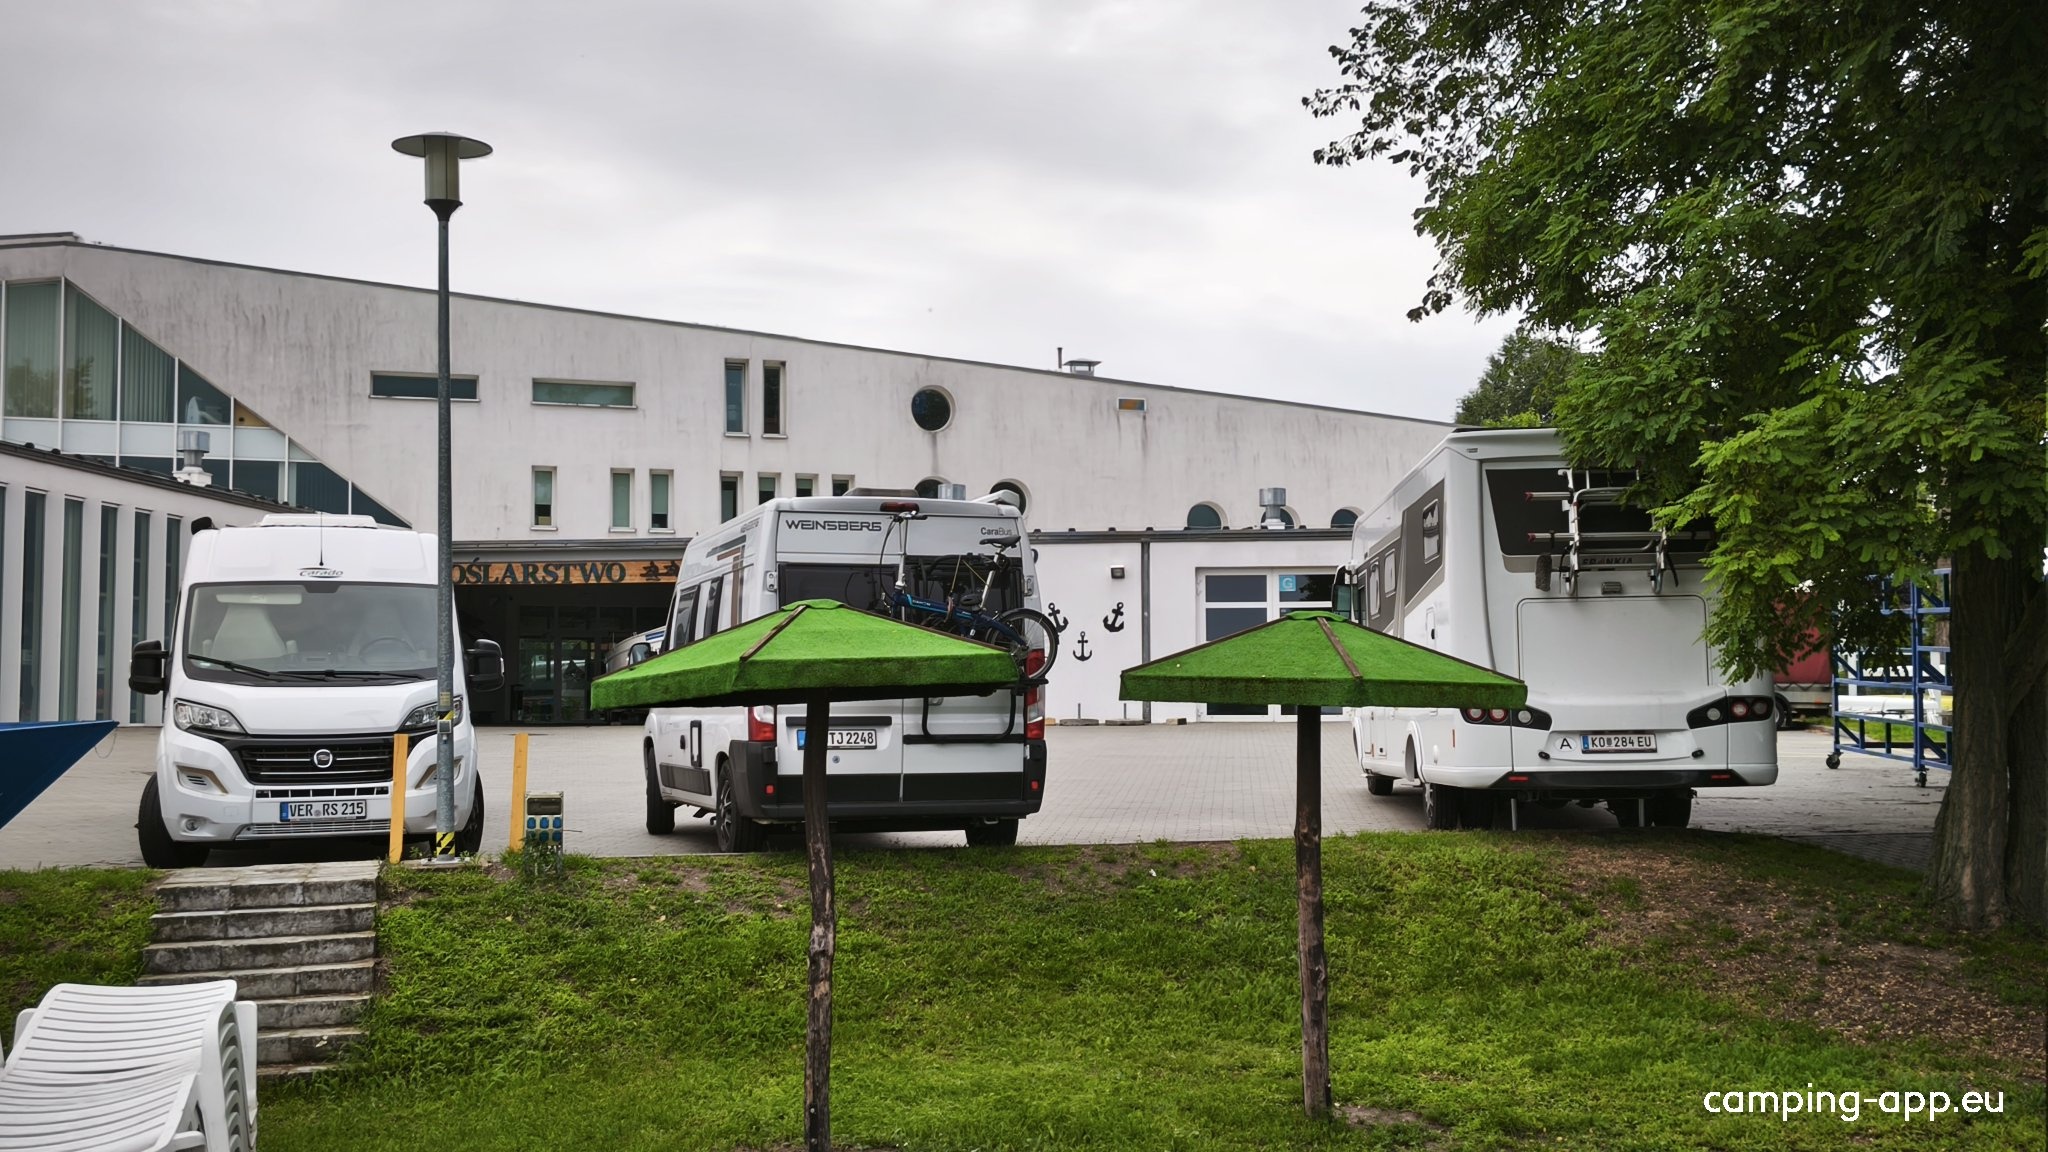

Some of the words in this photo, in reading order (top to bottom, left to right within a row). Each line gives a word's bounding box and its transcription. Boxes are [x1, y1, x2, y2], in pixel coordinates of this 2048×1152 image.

[786, 520, 882, 532] WEINSBERG
[451, 557, 626, 584] OŚLARSTWO
[1282, 577, 1293, 589] G
[828, 732, 844, 745] TJ
[846, 731, 874, 745] 2248
[1559, 737, 1573, 750] A
[1614, 736, 1635, 748] 284
[1637, 736, 1652, 748] EU
[289, 803, 313, 817] VER
[322, 803, 339, 817] RS
[341, 801, 364, 816] 215
